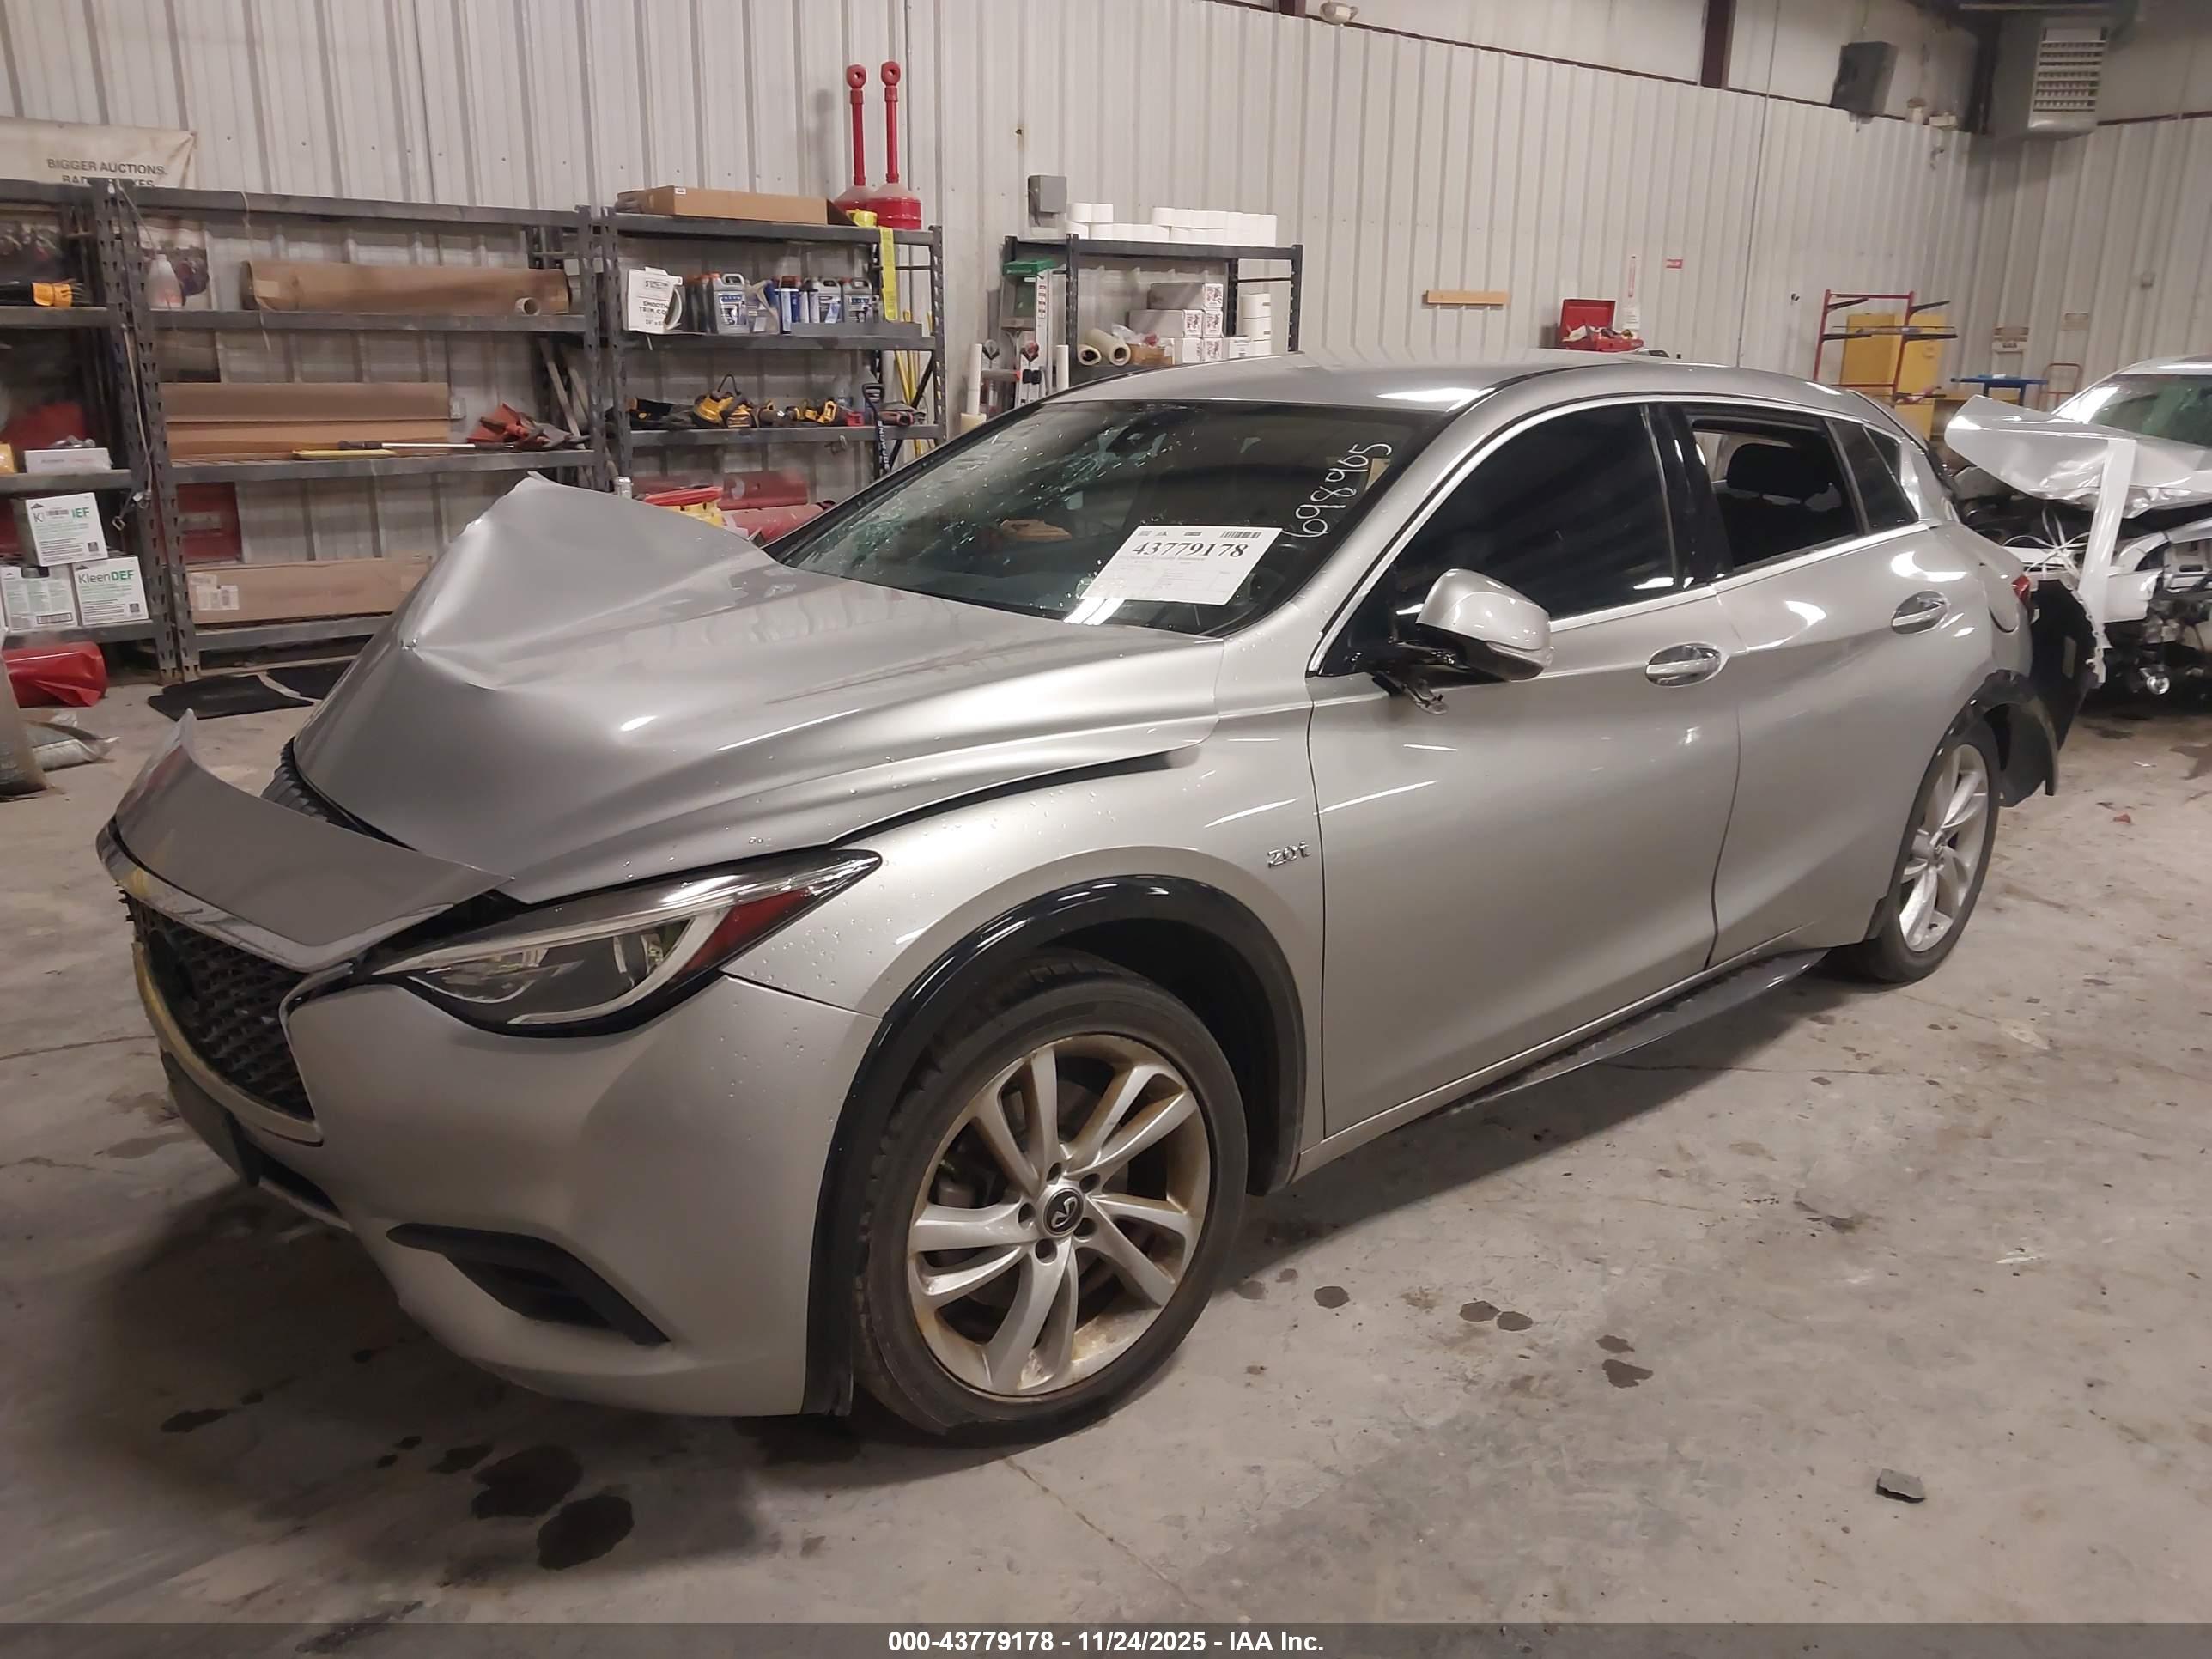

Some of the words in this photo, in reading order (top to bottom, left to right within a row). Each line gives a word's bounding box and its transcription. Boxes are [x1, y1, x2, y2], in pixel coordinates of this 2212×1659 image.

[46, 158, 97, 172] BIGGER
[1133, 542, 1249, 558] 43779178
[78, 569, 135, 585] KleenDEF
